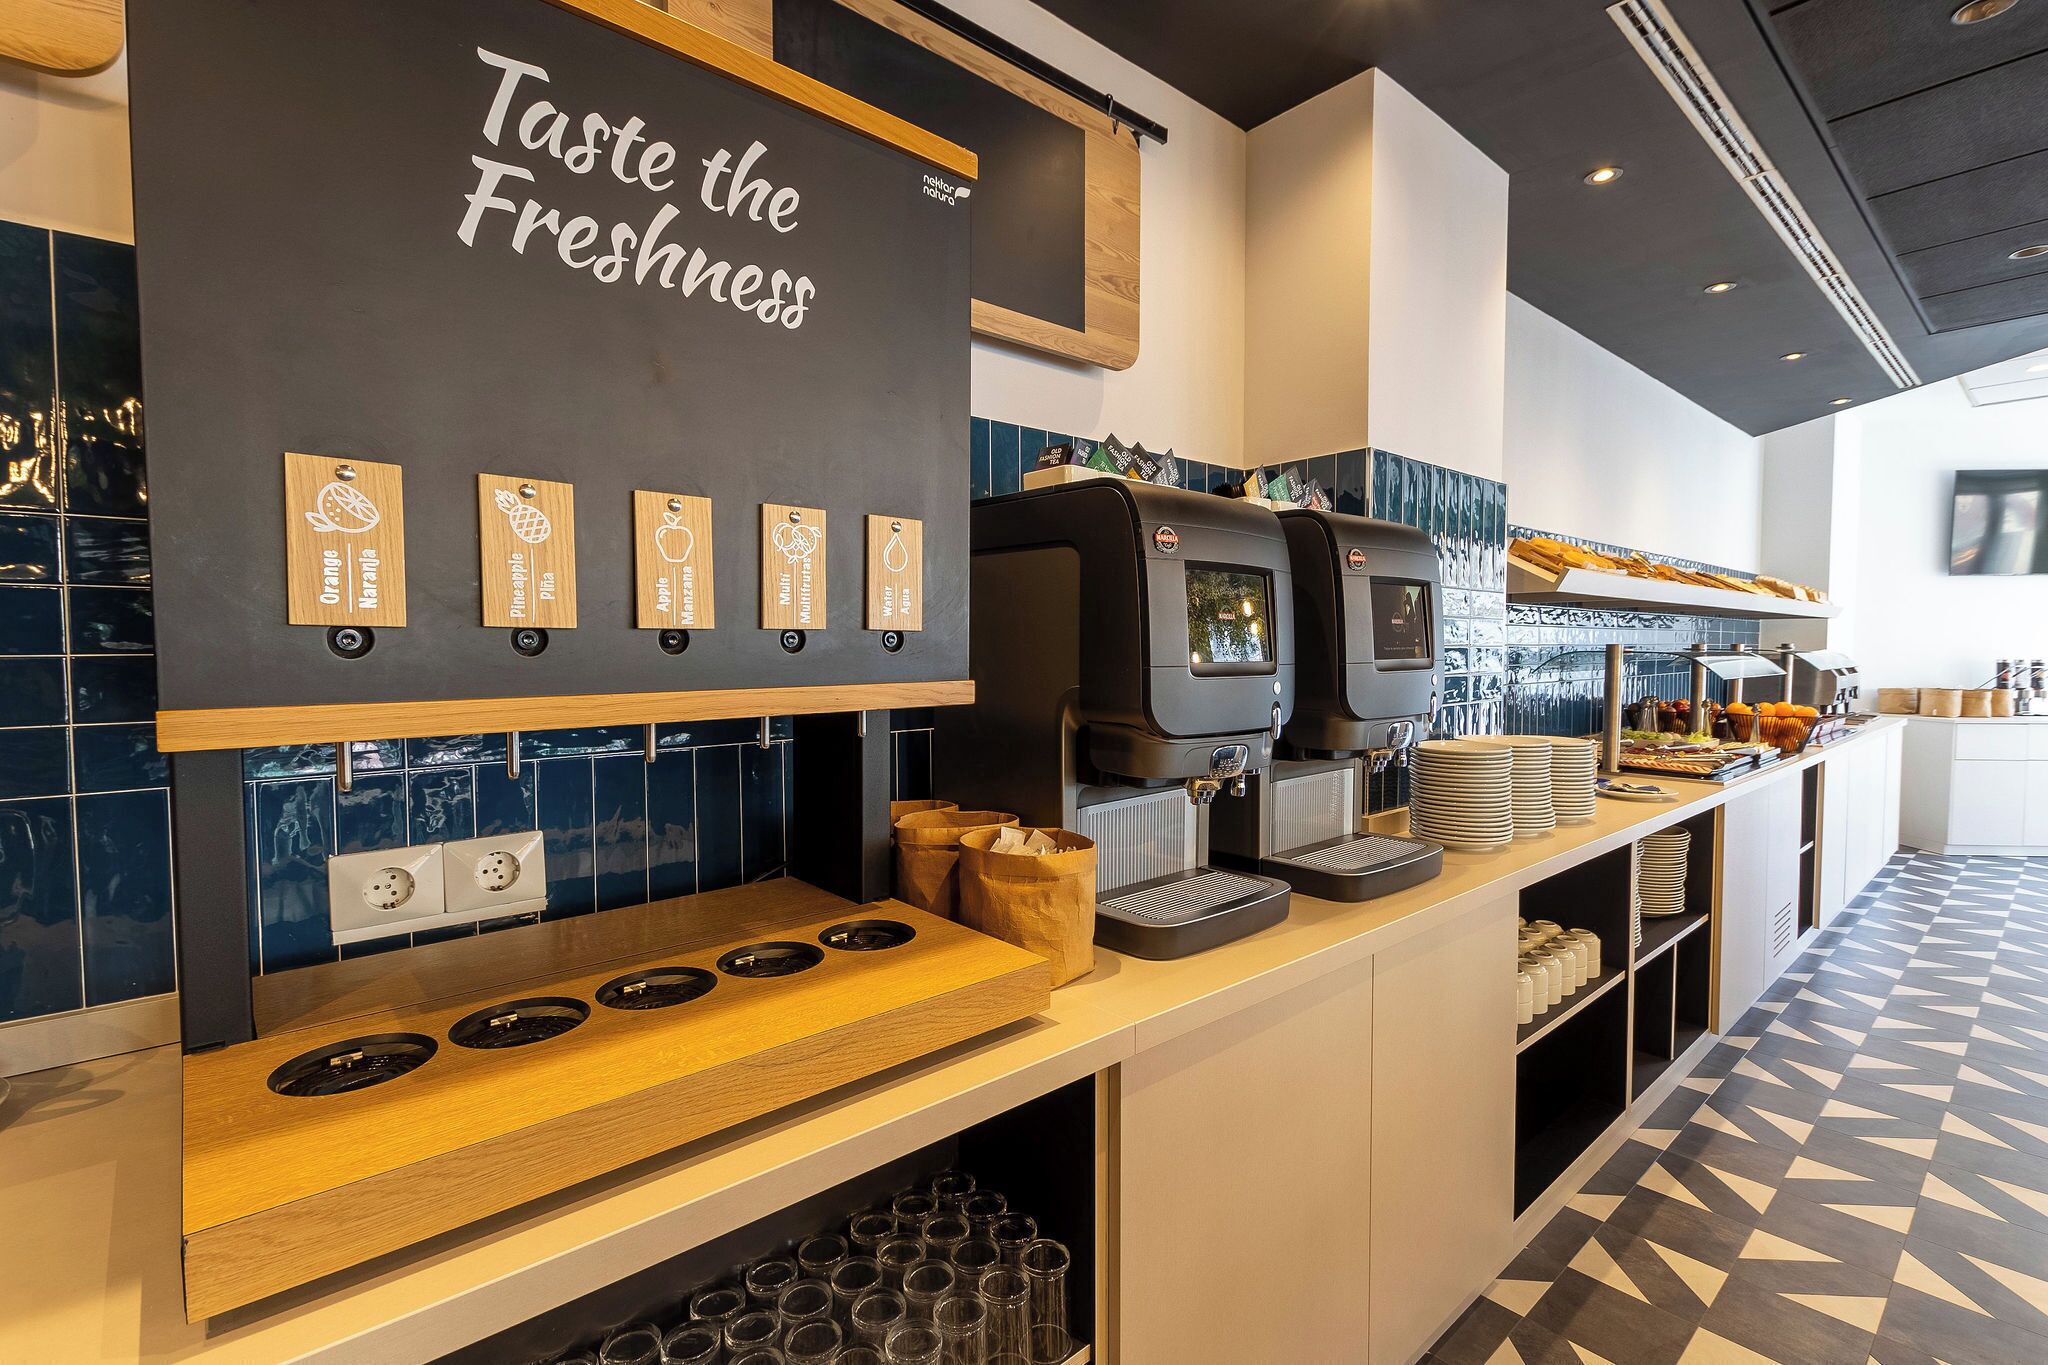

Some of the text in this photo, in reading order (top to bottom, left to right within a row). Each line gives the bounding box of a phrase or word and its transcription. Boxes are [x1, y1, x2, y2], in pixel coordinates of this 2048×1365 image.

[477, 46, 801, 233] Taste the
[923, 174, 955, 194] nektar
[923, 185, 955, 206] natura
[457, 154, 816, 330] Freshness
[1051, 447, 1062, 455] OLD
[1107, 445, 1129, 467] FASHION
[1115, 460, 1125, 472] TEA
[1121, 451, 1132, 463] OLD
[1146, 460, 1157, 472] OLD
[1140, 469, 1149, 481] TEA
[320, 549, 342, 605] Orange
[358, 548, 380, 609] Naranja
[508, 552, 528, 618] Pineapple
[540, 572, 555, 600] Piña
[780, 572, 791, 605] Multi
[800, 557, 812, 624] Multifrutas
[656, 577, 671, 612] Apple
[681, 566, 694, 625] Manzana
[882, 585, 893, 617] Water
[900, 588, 911, 615] Agua
